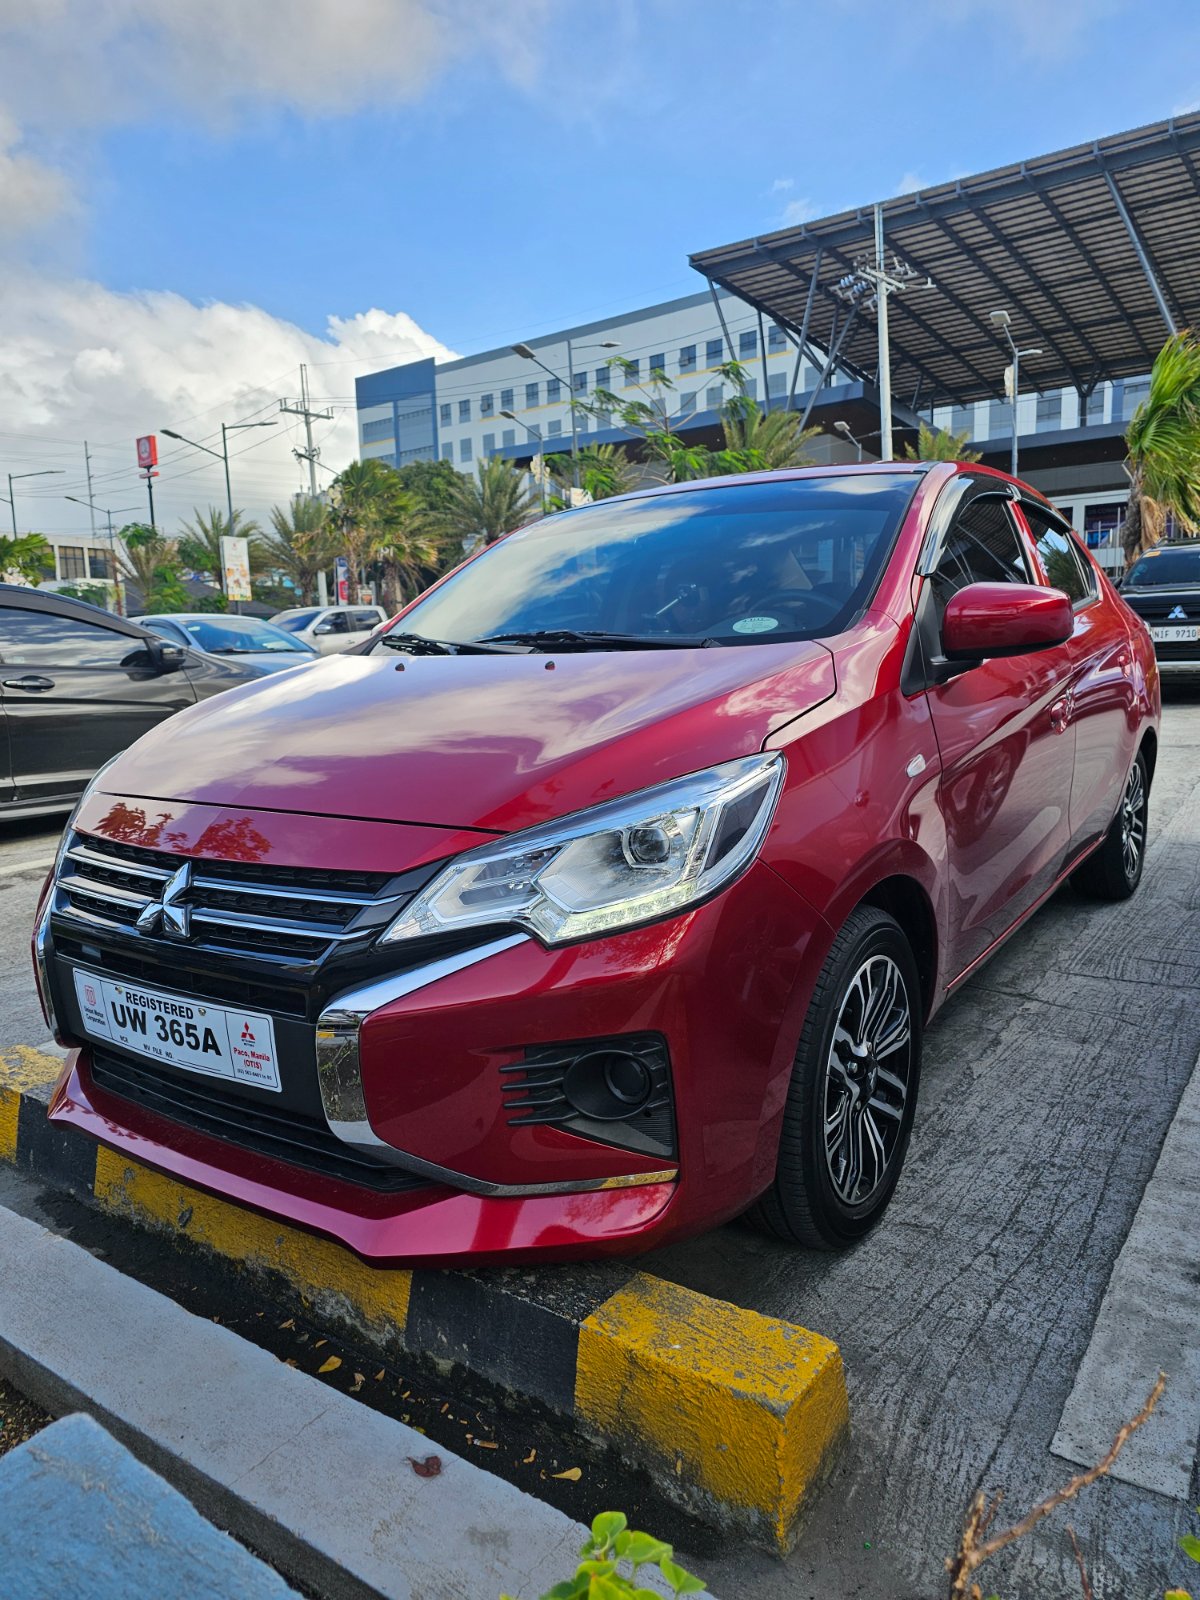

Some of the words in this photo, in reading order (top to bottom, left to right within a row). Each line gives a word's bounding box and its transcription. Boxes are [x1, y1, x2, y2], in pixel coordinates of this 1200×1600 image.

[1154, 630, 1170, 639] NIF
[125, 991, 194, 1020] REGISTERED
[111, 1000, 147, 1036] UW
[154, 1014, 223, 1057] 365A
[233, 1046, 250, 1058] Paco,
[250, 1050, 271, 1062] Manila
[243, 1059, 263, 1071] (OTIS)
